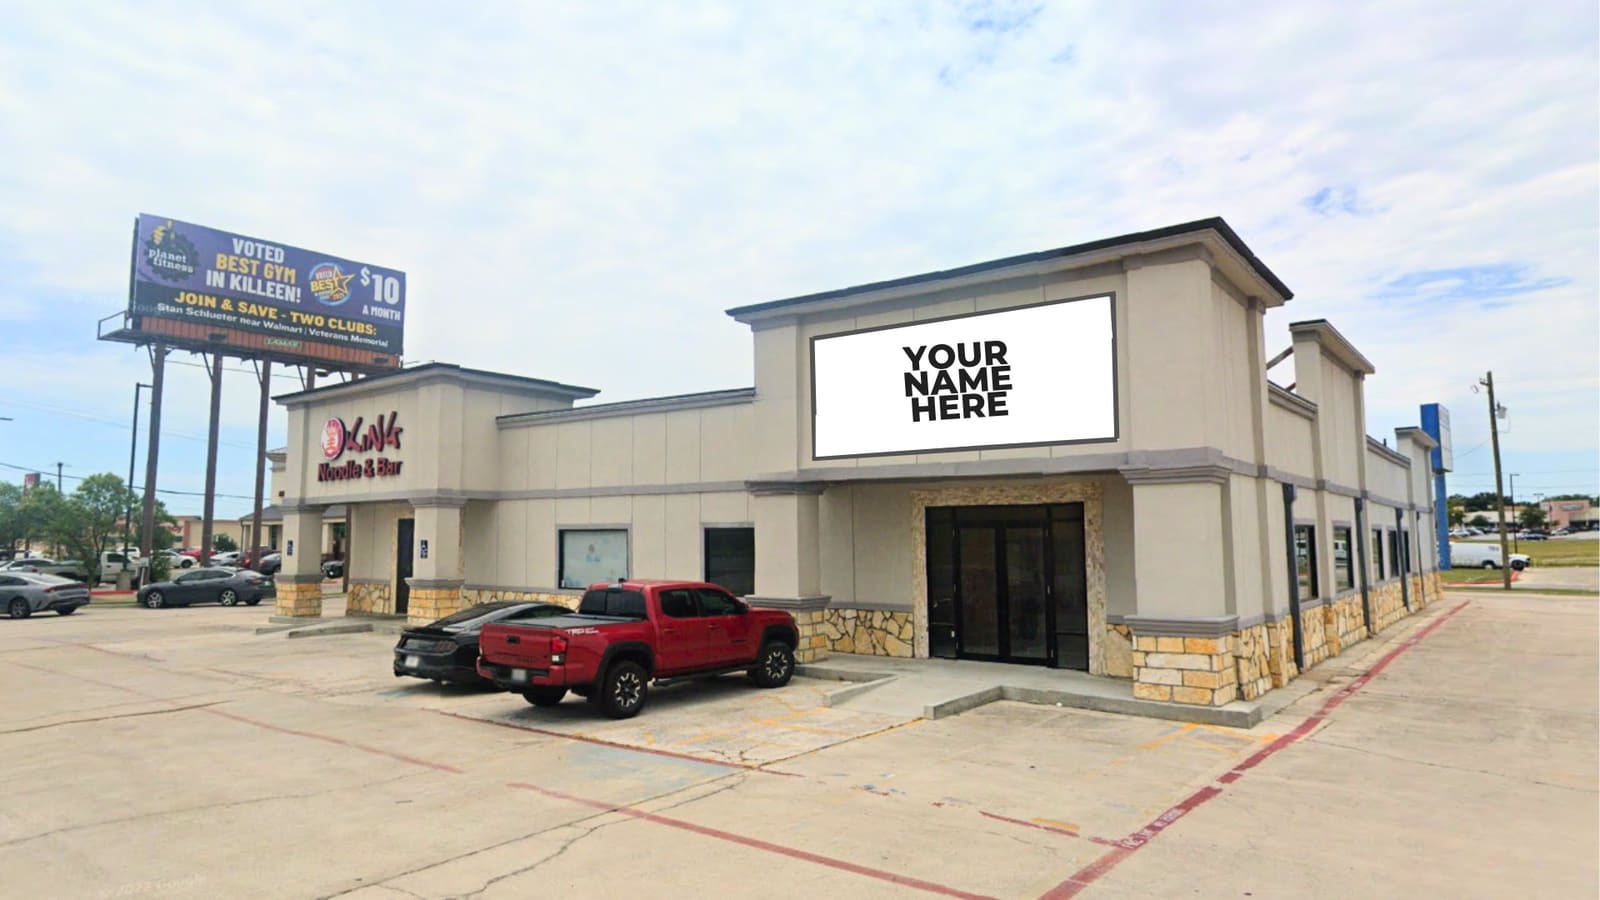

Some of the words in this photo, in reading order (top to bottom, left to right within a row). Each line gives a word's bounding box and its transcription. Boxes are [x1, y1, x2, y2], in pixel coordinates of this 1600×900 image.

[148, 248, 187, 263] planet
[153, 257, 194, 274] fitness
[232, 238, 284, 263] VOTED
[215, 253, 260, 276] BEST
[263, 263, 297, 285] GYM
[206, 269, 225, 289] IN
[229, 273, 301, 304] KILLEEN!
[361, 266, 400, 305] $10
[157, 302, 183, 314] Stan
[186, 307, 238, 323] Schlueter
[239, 316, 261, 328] near
[263, 320, 303, 335] Walmart
[309, 328, 349, 342] Veterans
[351, 335, 389, 348] Memorial
[174, 291, 217, 309] JOIN
[221, 299, 234, 311] &
[238, 301, 278, 320] SAVE
[290, 311, 325, 327] TWO
[328, 317, 377, 336] CLUBS:
[361, 305, 370, 316] A
[370, 306, 401, 321] MONTH
[902, 341, 1008, 371] YOUR
[904, 365, 1013, 397] NAME
[911, 391, 1009, 422] HERE
[318, 460, 362, 482] Noodle
[364, 458, 375, 478] &
[377, 457, 403, 476] Bar
